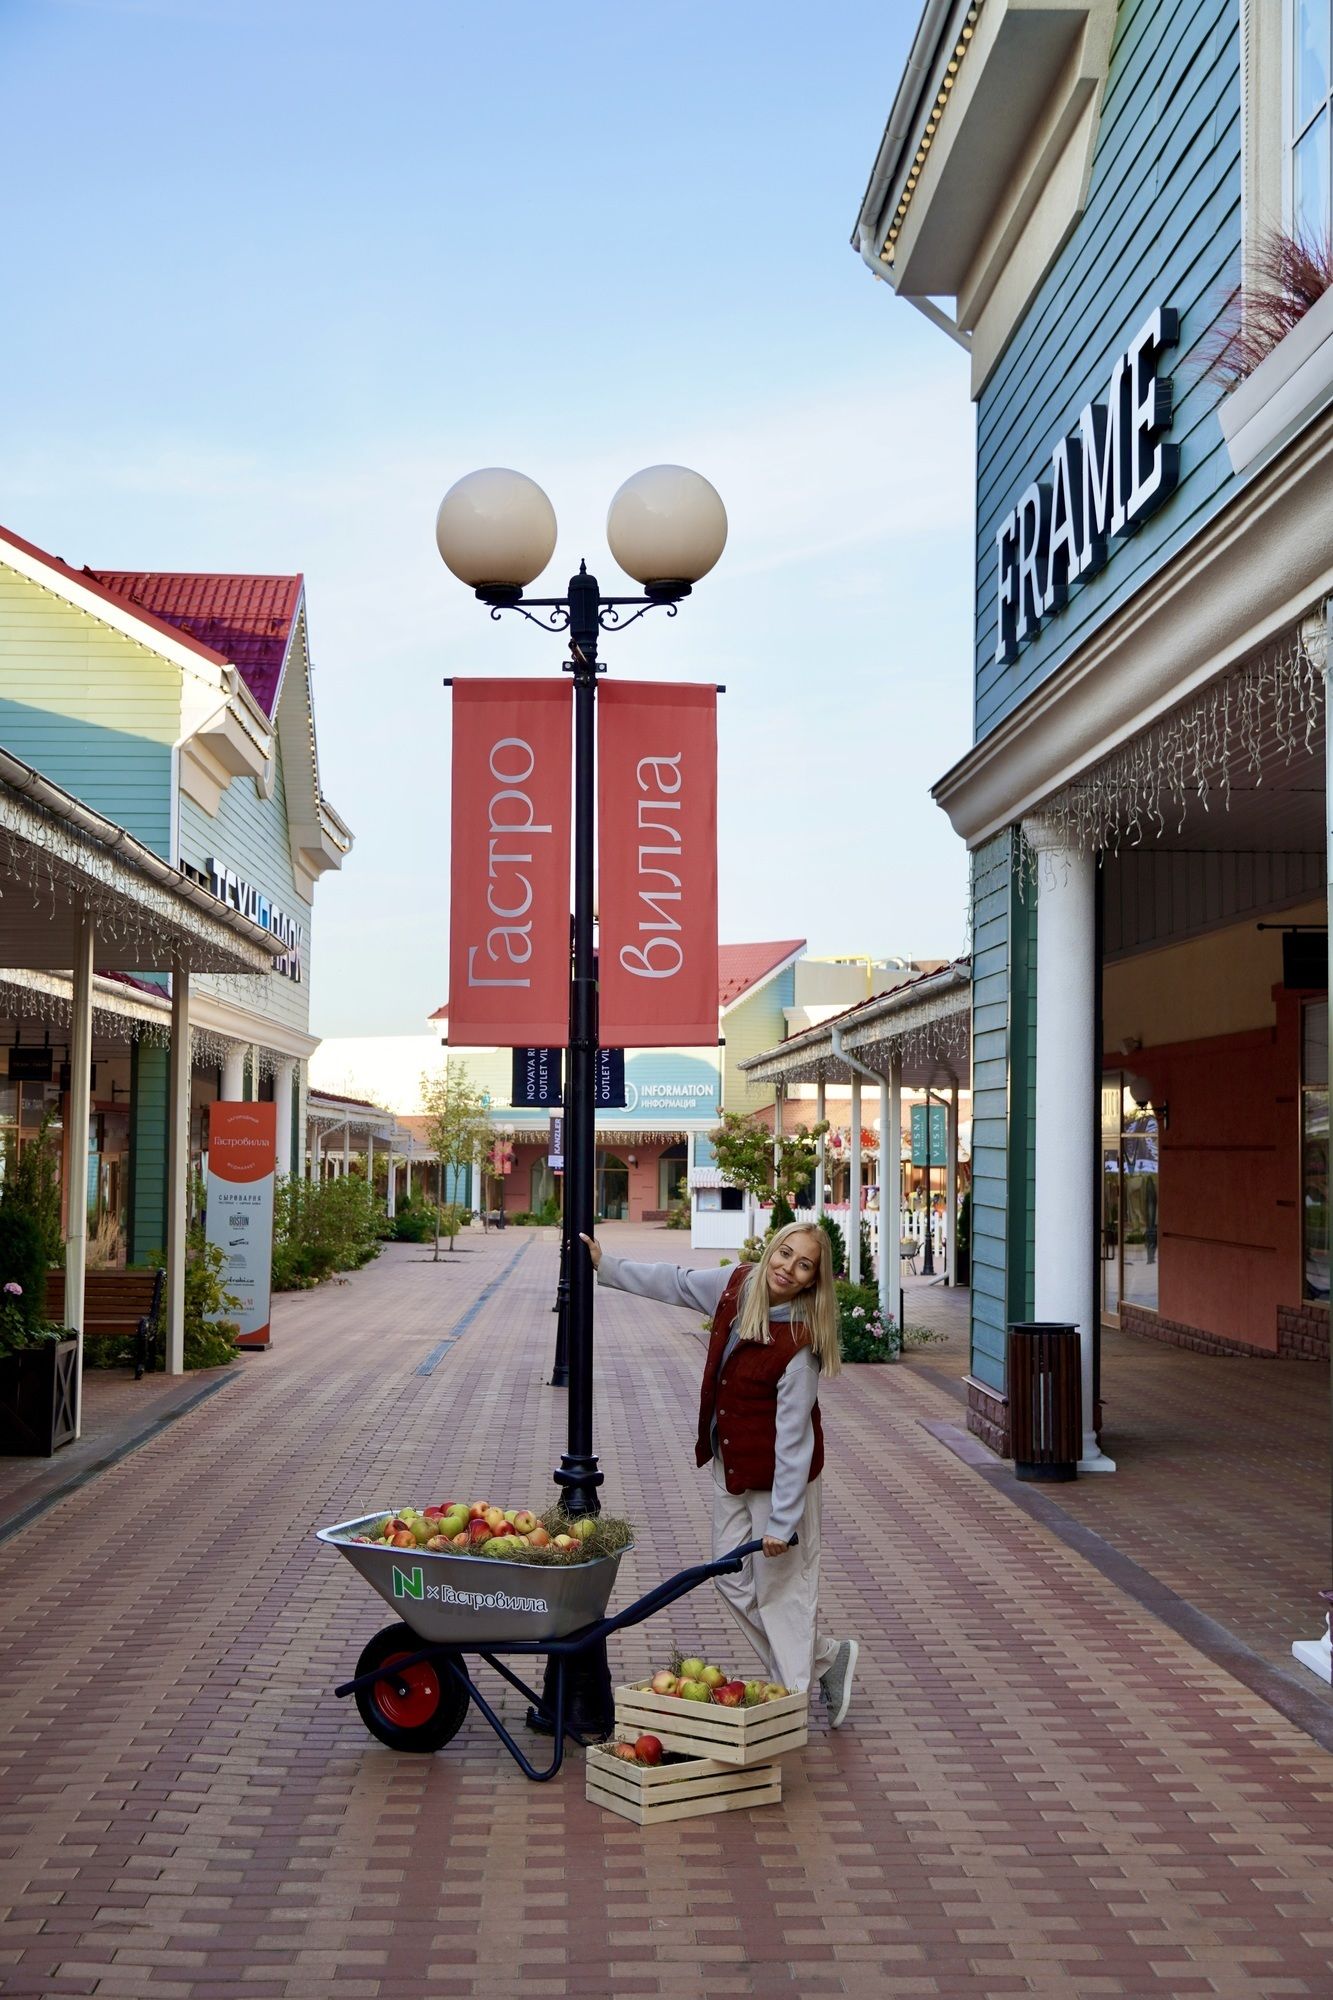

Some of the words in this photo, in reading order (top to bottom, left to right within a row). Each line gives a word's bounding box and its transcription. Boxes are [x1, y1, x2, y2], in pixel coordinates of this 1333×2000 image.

[995, 306, 1179, 664] FRAME
[468, 737, 552, 988] Гастро
[619, 751, 684, 979] вилла
[527, 1059, 535, 1100] NOVAYA
[539, 1066, 548, 1100] OUTLET
[601, 1066, 610, 1100] OUTLET
[641, 1084, 713, 1096] INFORMATION
[641, 1098, 696, 1108] ИНФОРМАЦИЯ
[214, 1136, 270, 1147] Гастровилла
[553, 1118, 562, 1154] KANZLER
[441, 1584, 548, 1613] Гастровилла
